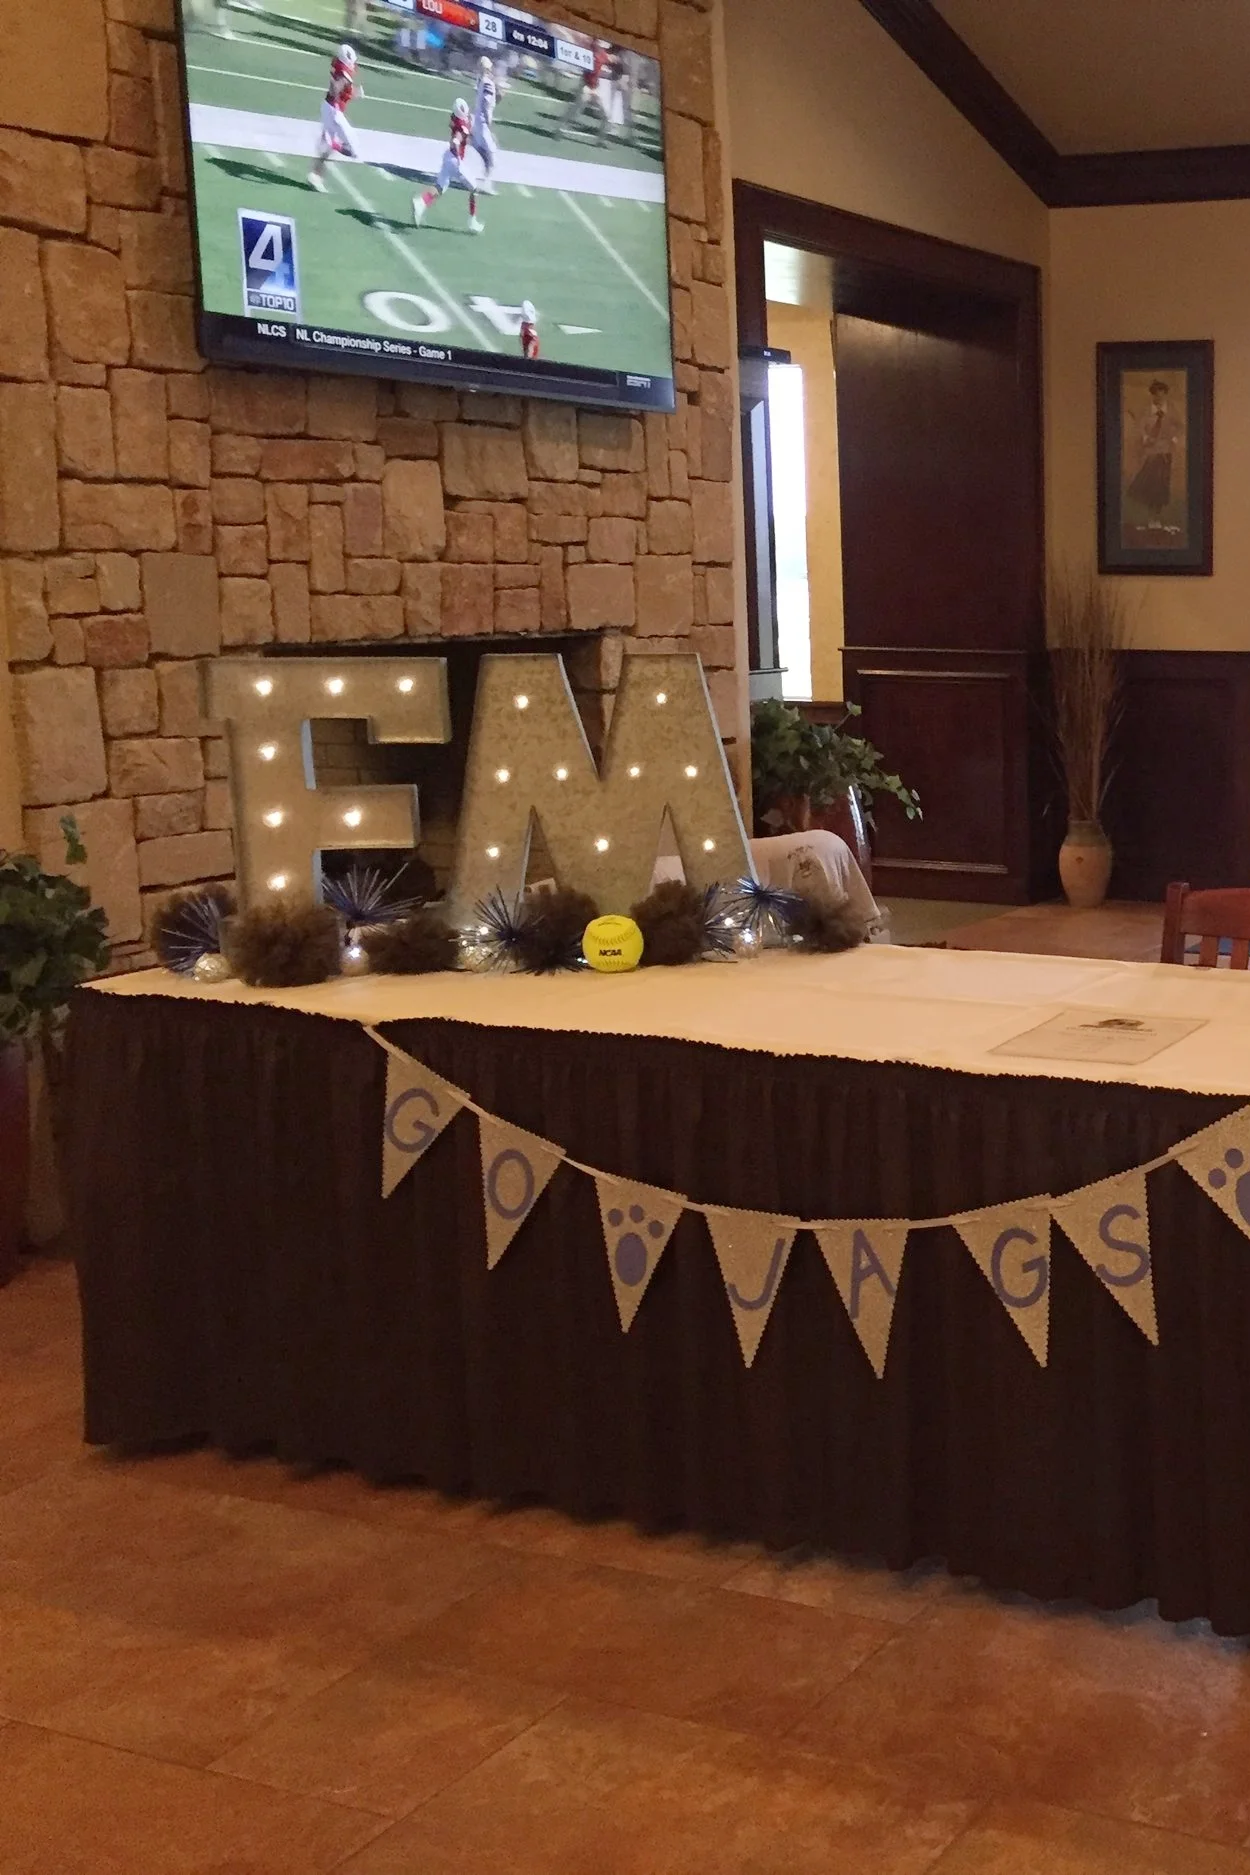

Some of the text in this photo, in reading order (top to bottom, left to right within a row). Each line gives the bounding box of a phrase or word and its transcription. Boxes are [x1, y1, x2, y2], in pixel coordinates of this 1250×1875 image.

[485, 19, 497, 33] 28
[248, 223, 290, 287] 4
[257, 322, 287, 338] NLCS
[295, 328, 312, 342] NL
[312, 330, 382, 353] Championship
[382, 340, 412, 356] Series
[418, 345, 446, 360] Game
[446, 350, 452, 361] 1
[626, 375, 652, 389] ESPN
[598, 948, 622, 957] NCAA
